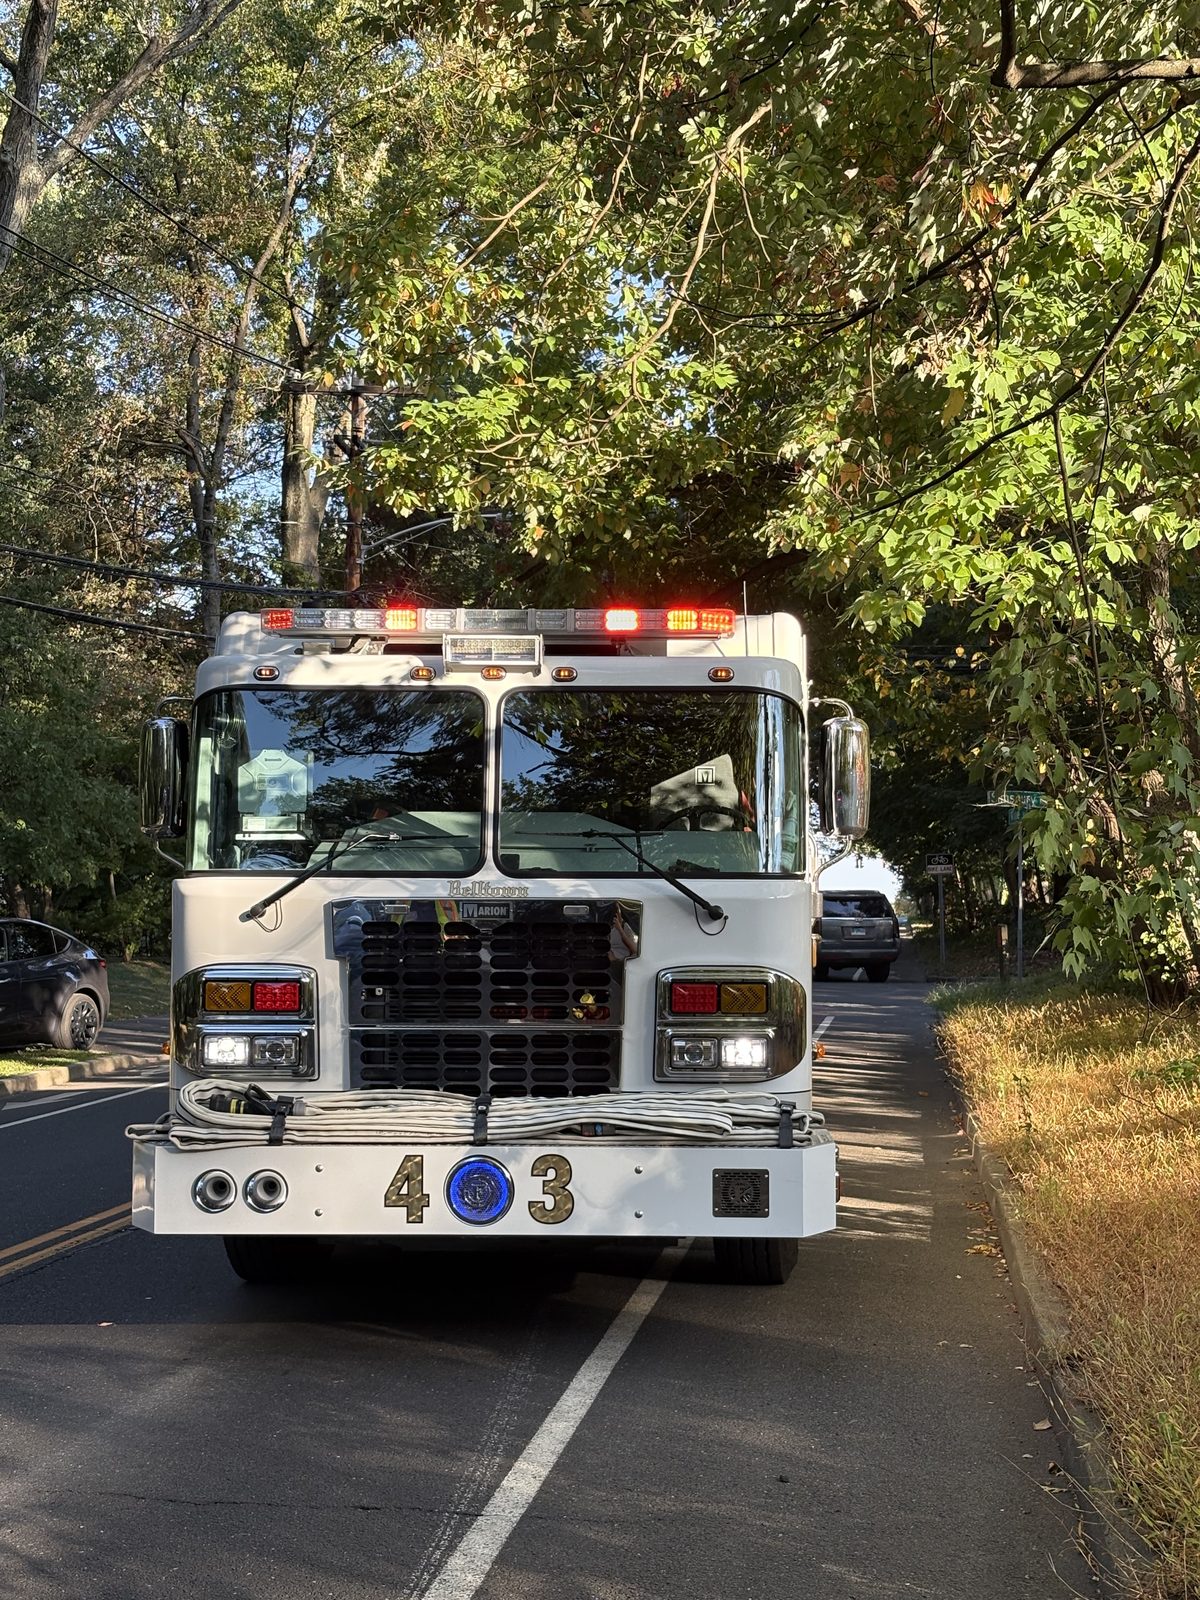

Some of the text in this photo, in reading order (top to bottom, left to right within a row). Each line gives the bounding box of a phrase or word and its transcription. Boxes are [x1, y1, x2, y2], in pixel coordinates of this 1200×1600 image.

[447, 880, 529, 898] Belltown
[463, 903, 508, 918] MARION
[384, 1153, 575, 1225] 4 3
